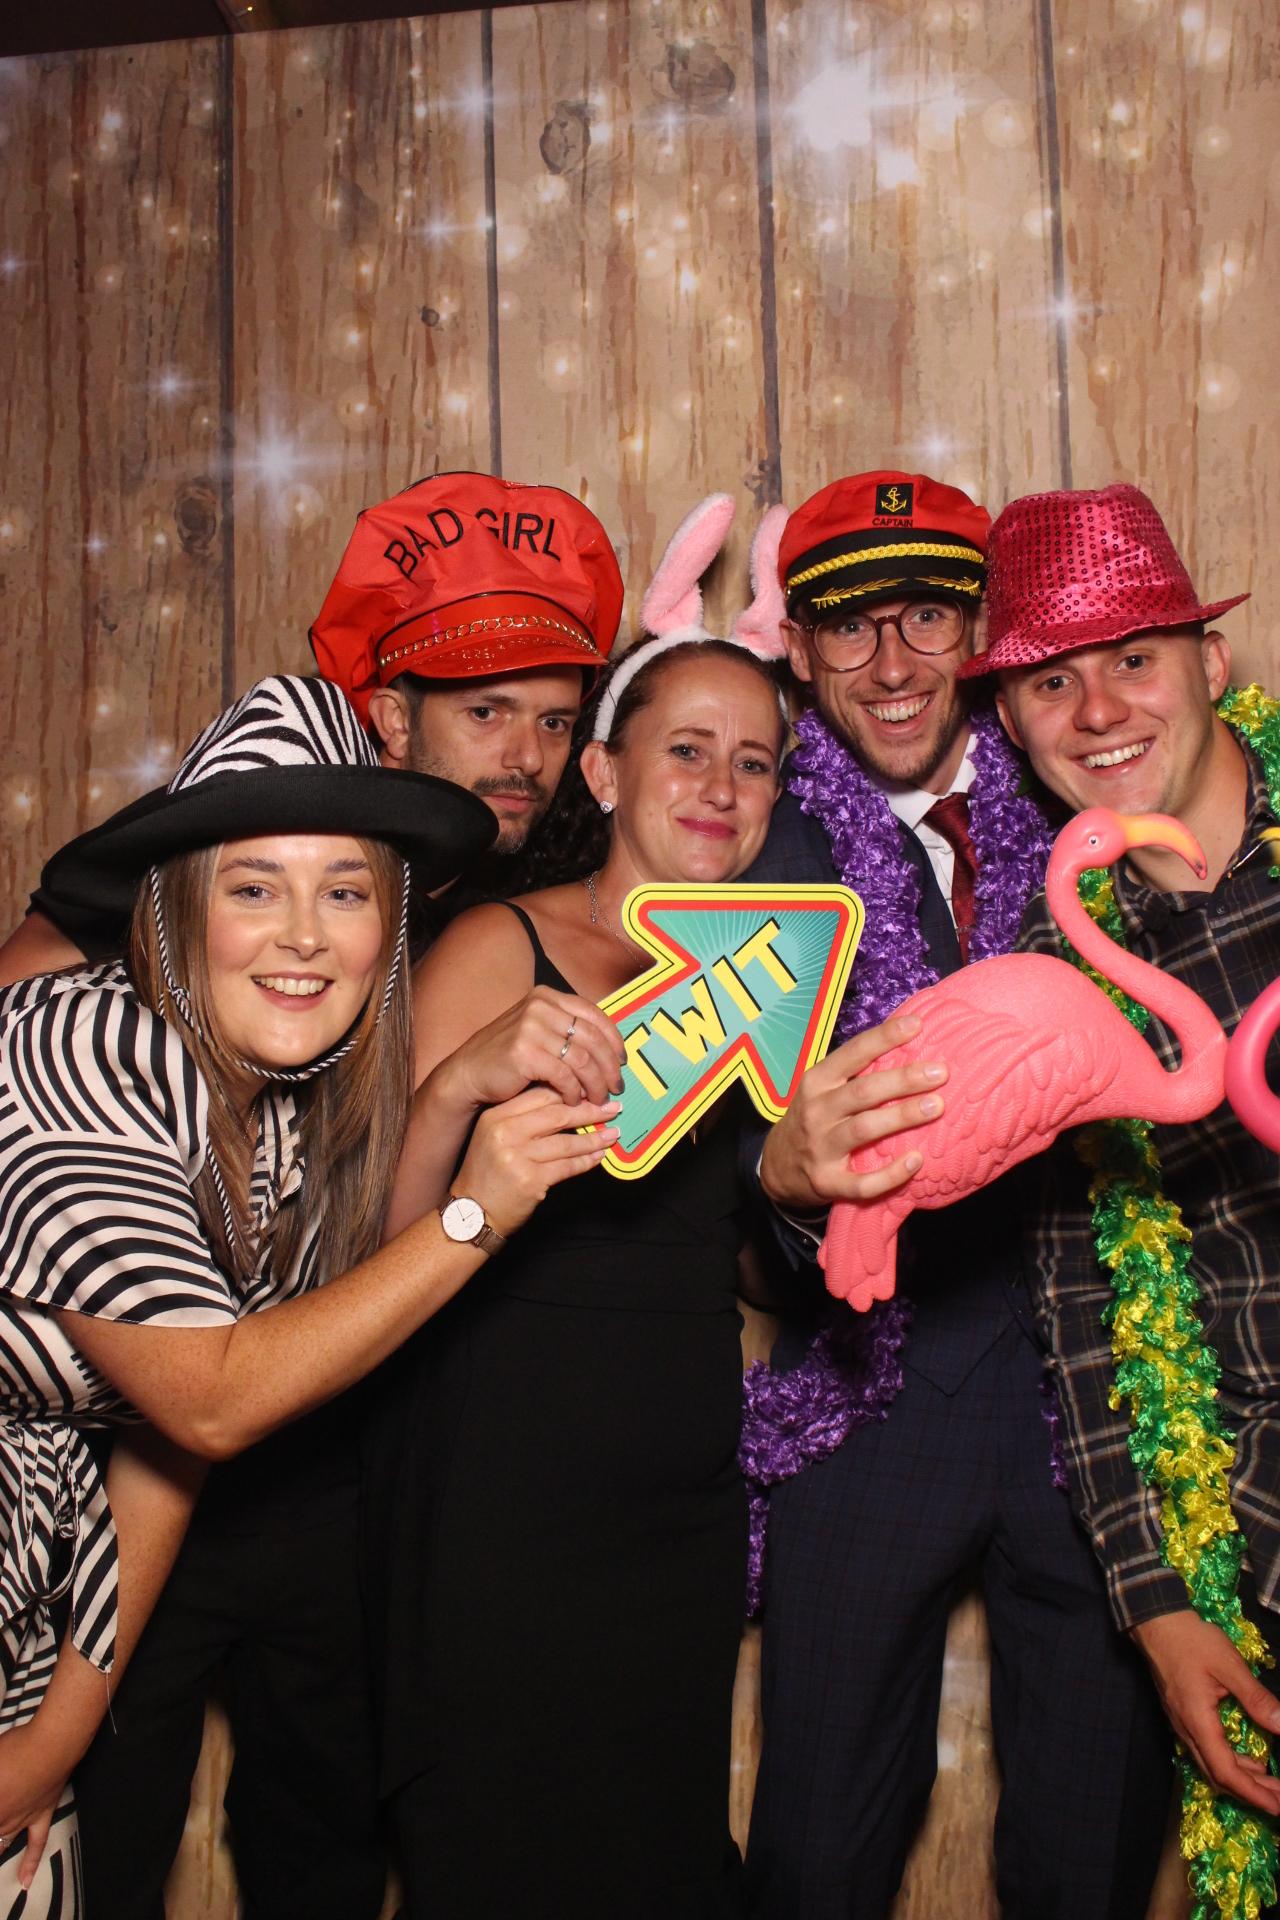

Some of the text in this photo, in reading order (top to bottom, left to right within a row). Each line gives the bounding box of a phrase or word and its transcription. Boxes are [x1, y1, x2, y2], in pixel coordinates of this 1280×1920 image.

[383, 507, 464, 583] BAD
[872, 517, 913, 528] CAPTAIN
[623, 916, 798, 1101] TWIT
